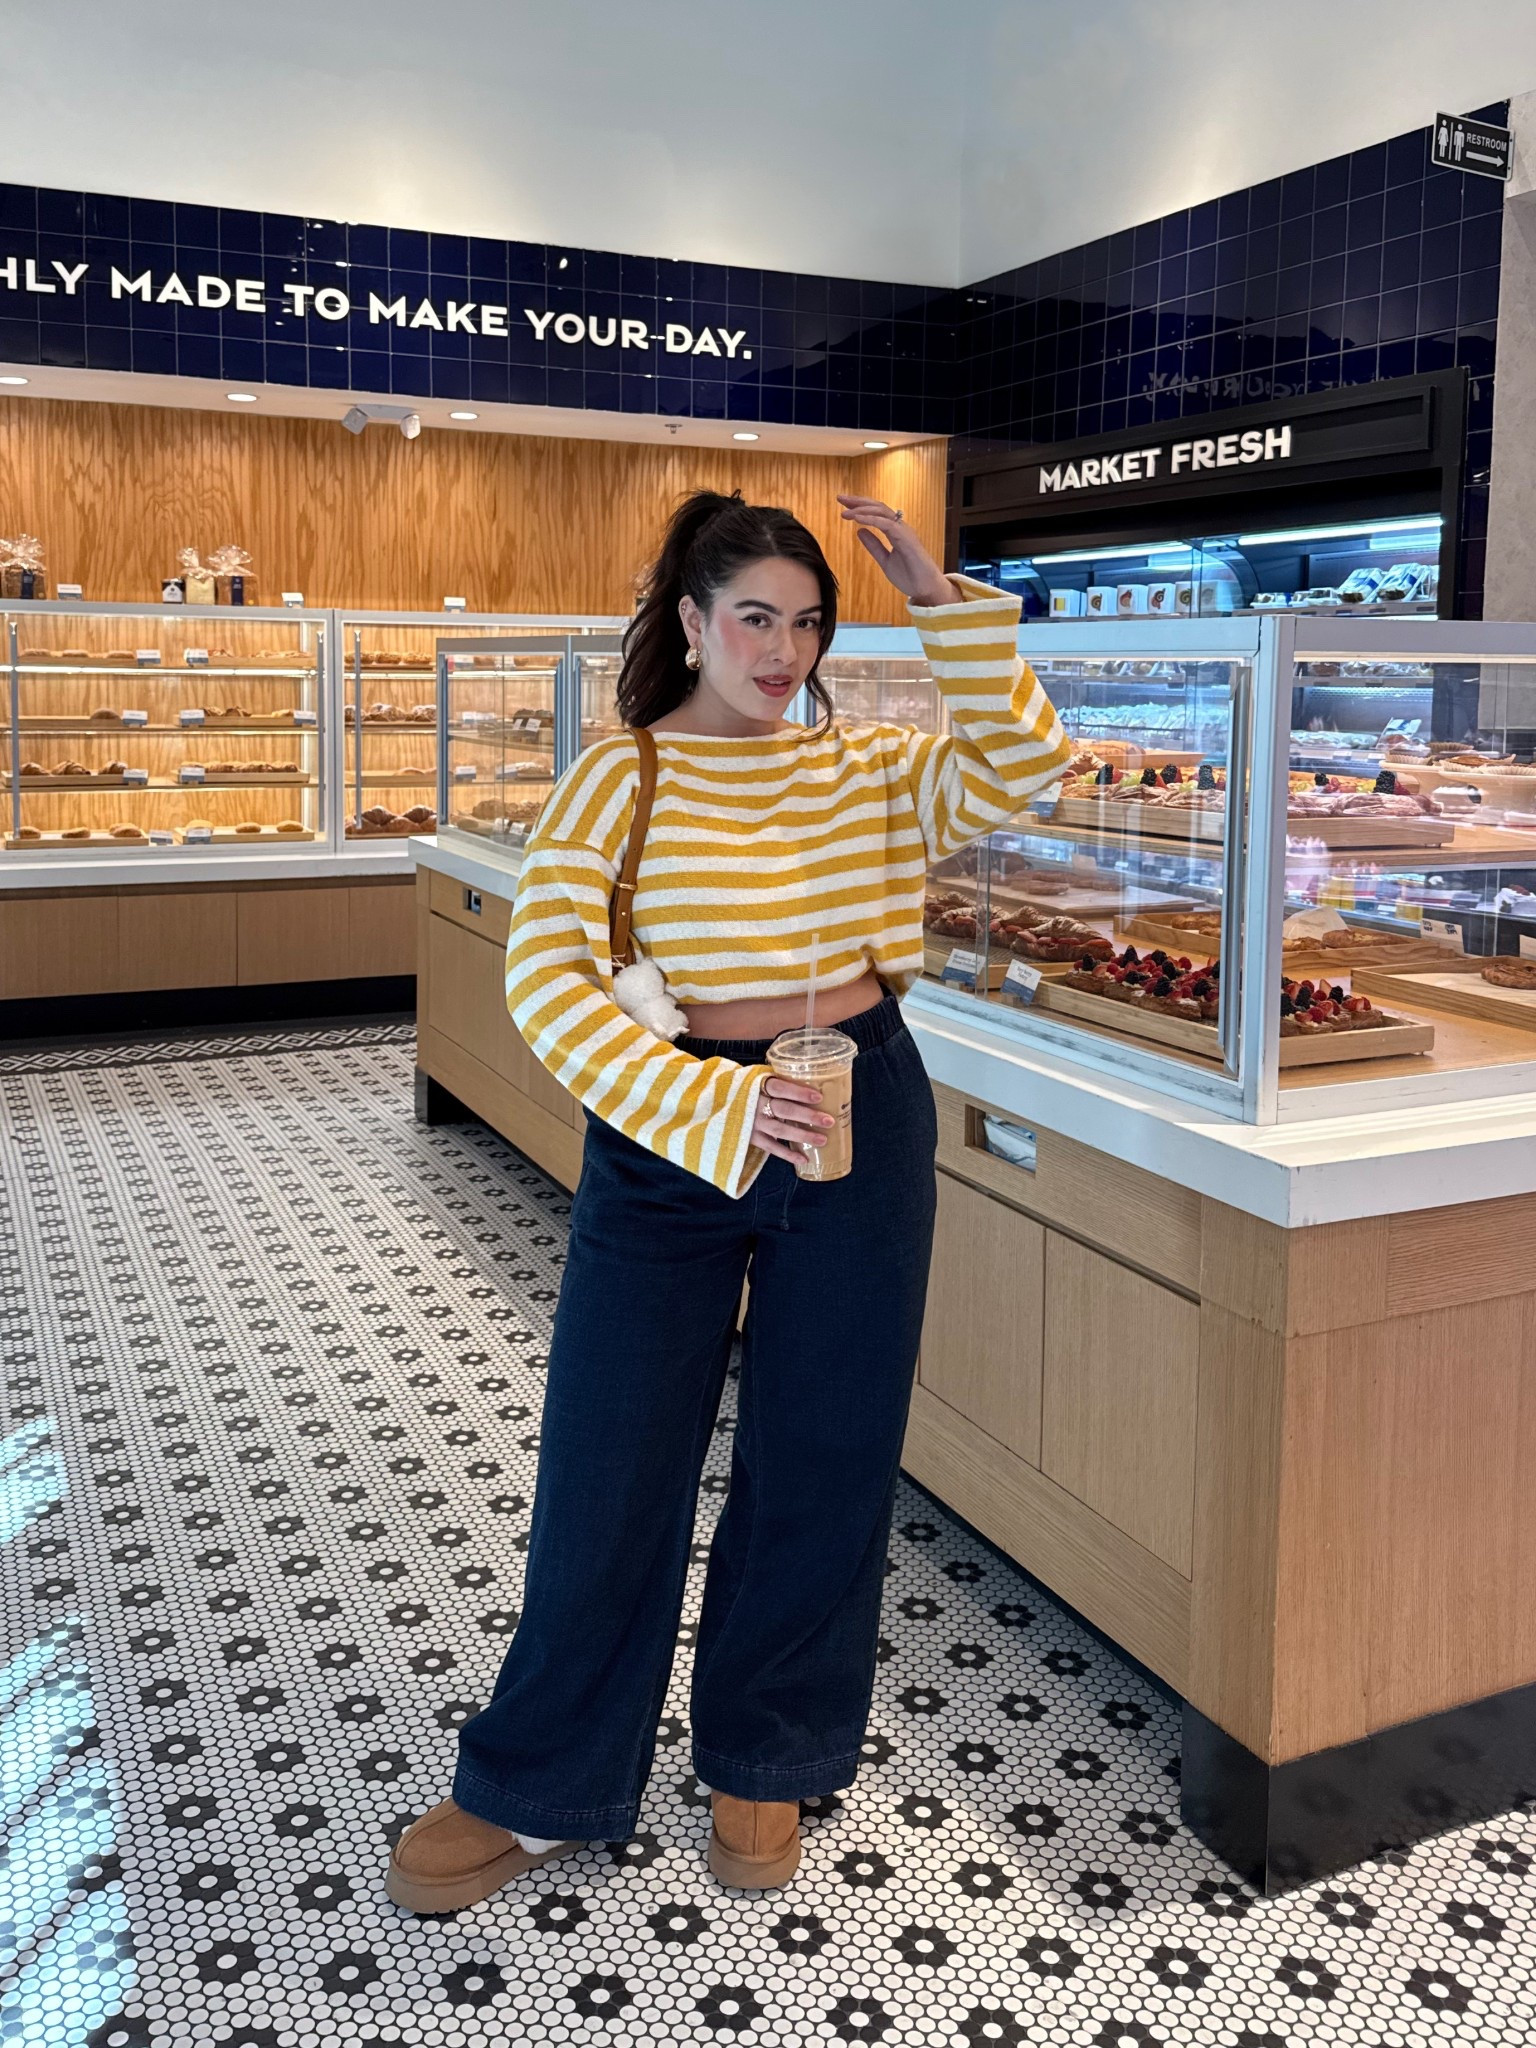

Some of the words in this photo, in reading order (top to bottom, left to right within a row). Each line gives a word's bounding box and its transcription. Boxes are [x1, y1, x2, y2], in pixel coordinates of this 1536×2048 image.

[1466, 132, 1507, 152] RESTROOM
[111, 265, 266, 313] MADE
[284, 284, 350, 321] TO
[369, 291, 509, 337] MAKE
[524, 309, 649, 350] YOUR
[665, 323, 752, 360] DAY.
[1039, 447, 1163, 494] MARKET
[1171, 425, 1292, 475] FRESH
